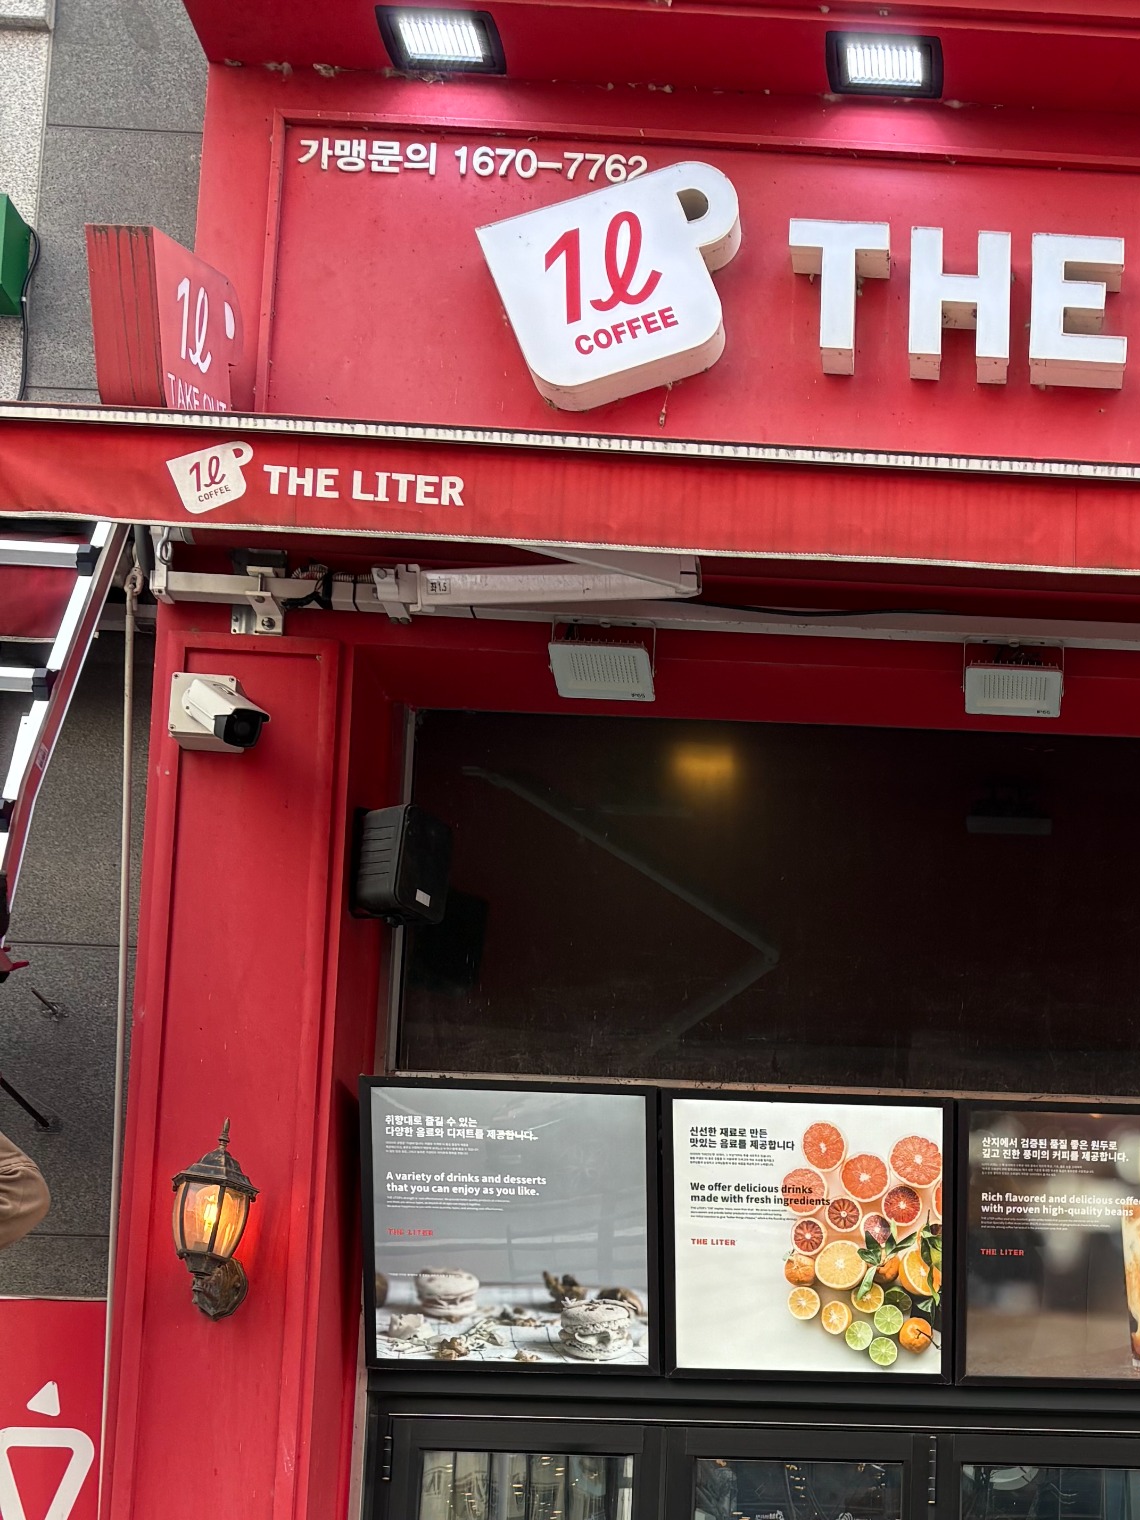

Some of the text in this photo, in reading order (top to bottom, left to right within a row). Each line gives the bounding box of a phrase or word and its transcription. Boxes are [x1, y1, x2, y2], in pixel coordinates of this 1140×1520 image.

[299, 138, 648, 183] 가맹문의 1670-7762
[789, 218, 1128, 385] THE
[574, 306, 679, 355] COFFEE
[263, 464, 465, 507] THE LITER
[197, 483, 232, 504] COFFEE
[385, 1115, 477, 1128] 취향대로 즐길 수 있는
[385, 1126, 413, 1137] 다양한
[416, 1127, 444, 1138] 음료와
[447, 1128, 484, 1139] 디저트를
[690, 1126, 768, 1139] 신선한 재료로 만든
[690, 1138, 795, 1151] 맛있는 음료를 제공합니다
[982, 1137, 1117, 1151] 산지에서 검증된 품질 좋은 원두로
[982, 1149, 1129, 1162] 깊고 진한 풍미의 커피를 제공합니다.
[386, 1172, 546, 1185] A variety of drinks and desserts
[387, 1183, 539, 1197] that you can enjoy as you like.
[690, 1182, 813, 1194] We offer delicious drinks
[690, 1194, 831, 1206] made with fresh ingredients
[981, 1192, 1002, 1202] Rich
[1005, 1193, 1046, 1203] flavored
[1049, 1194, 1067, 1204] and
[1069, 1195, 1112, 1205] delicious
[981, 1203, 1134, 1217] with proven high-quality beans
[388, 1228, 404, 1236] THE
